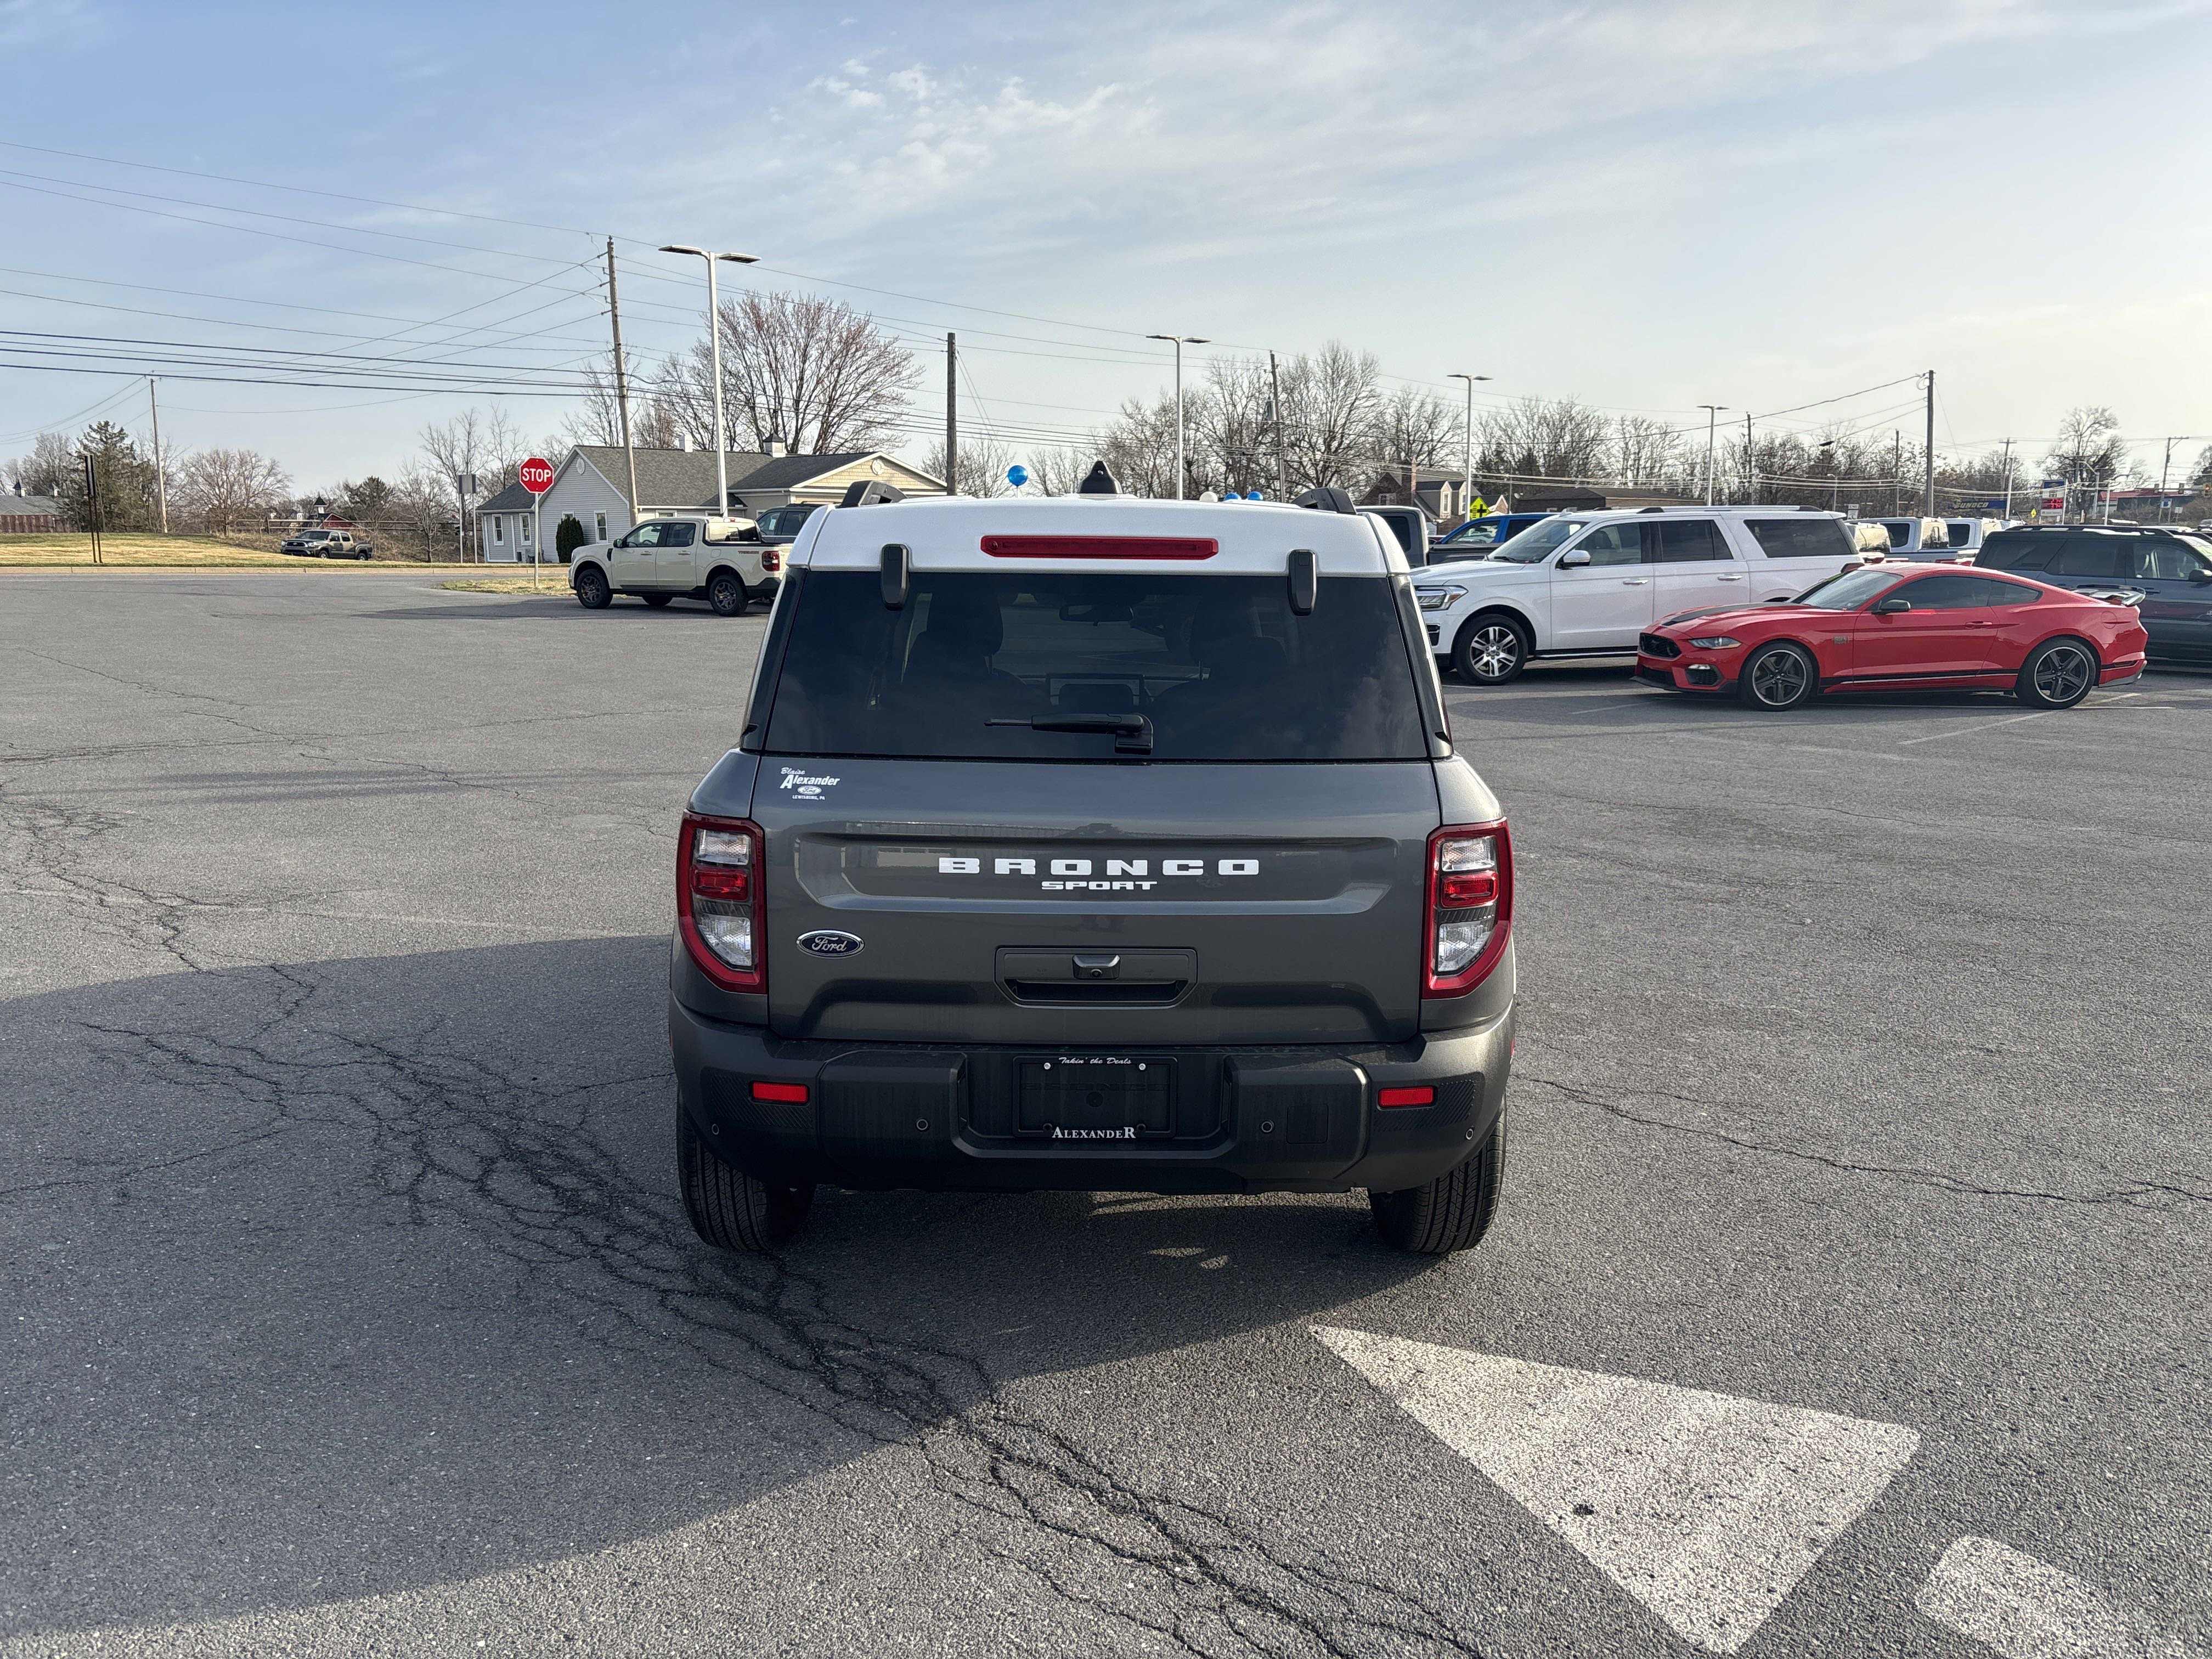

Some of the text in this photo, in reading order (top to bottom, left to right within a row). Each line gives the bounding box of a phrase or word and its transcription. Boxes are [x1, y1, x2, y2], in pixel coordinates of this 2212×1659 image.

[522, 467, 551, 482] STOP
[780, 775, 840, 789] Alexander
[938, 857, 1260, 876] BRONCO
[1041, 881, 1158, 890] SPORT
[811, 936, 848, 951] Ford
[1052, 1126, 1136, 1138] ALEXANDER
